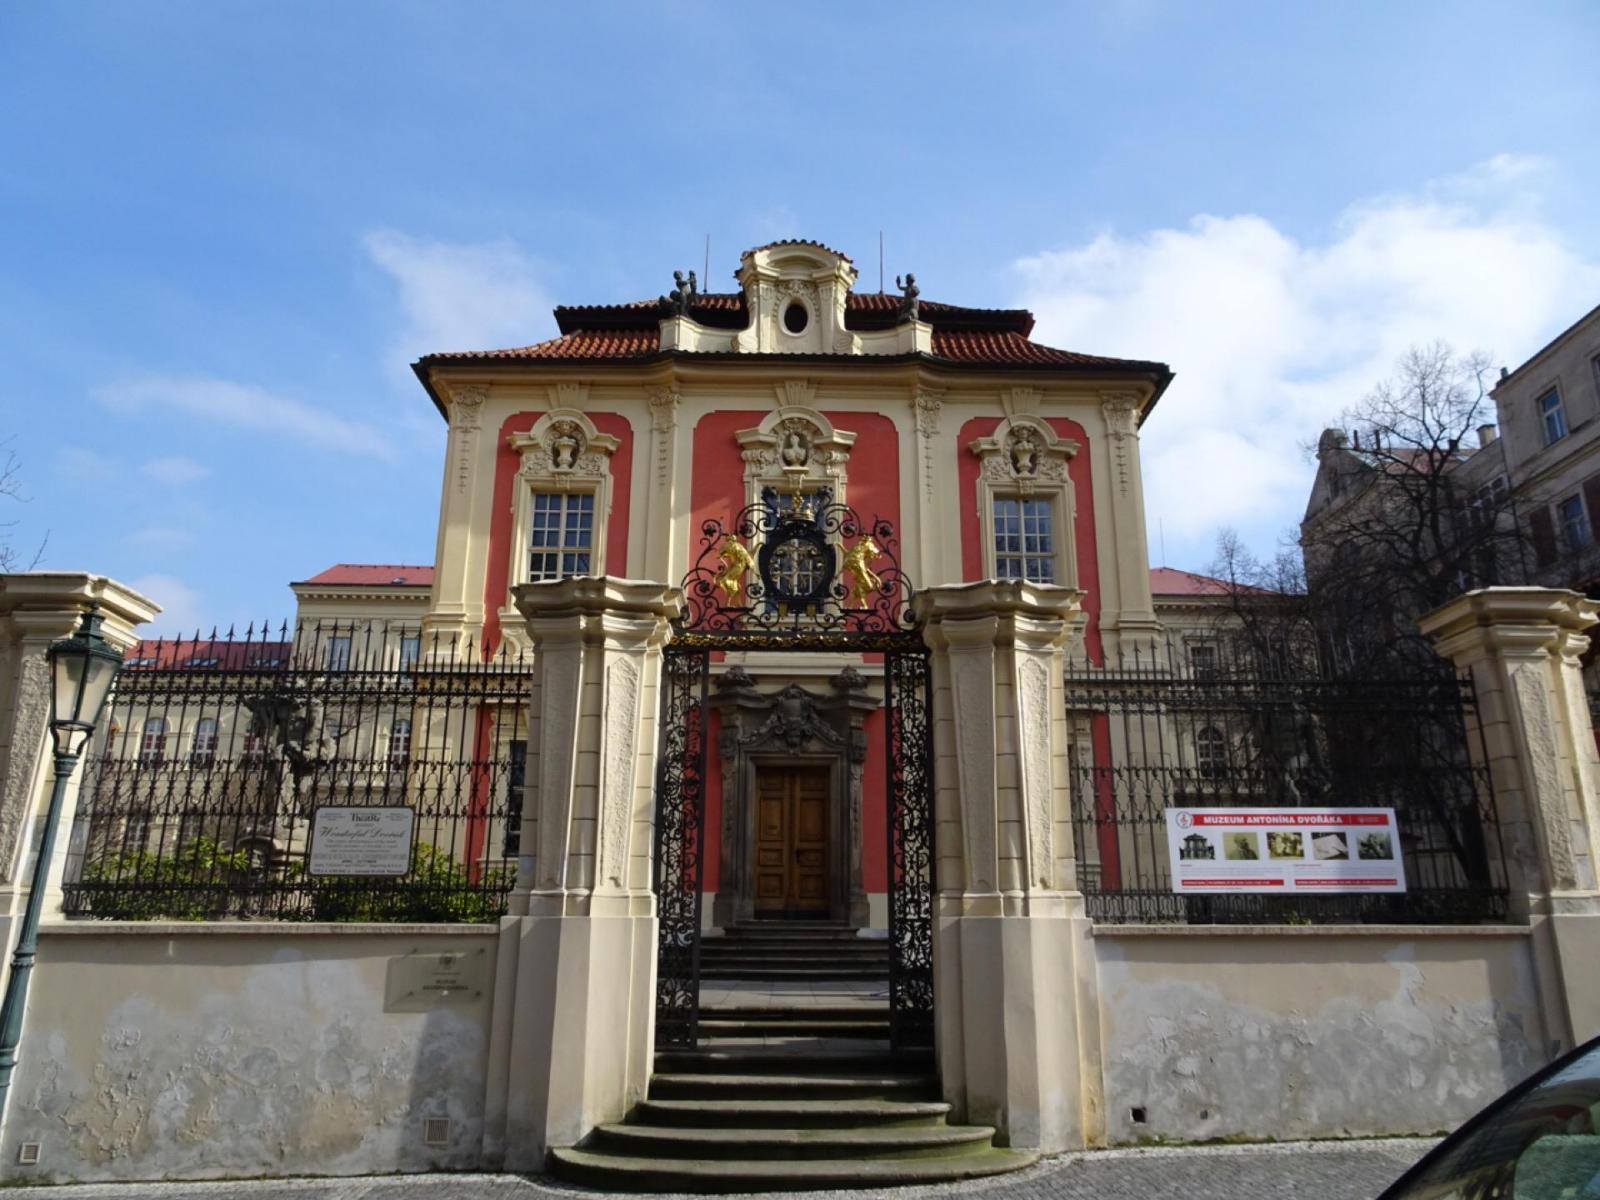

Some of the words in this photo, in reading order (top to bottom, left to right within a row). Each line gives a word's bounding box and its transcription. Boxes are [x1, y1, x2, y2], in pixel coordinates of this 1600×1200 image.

[1203, 815, 1244, 824] MUZEUM
[1246, 814, 1295, 824] ANTONÍNA
[1297, 814, 1343, 824] DVOŘÁKA
